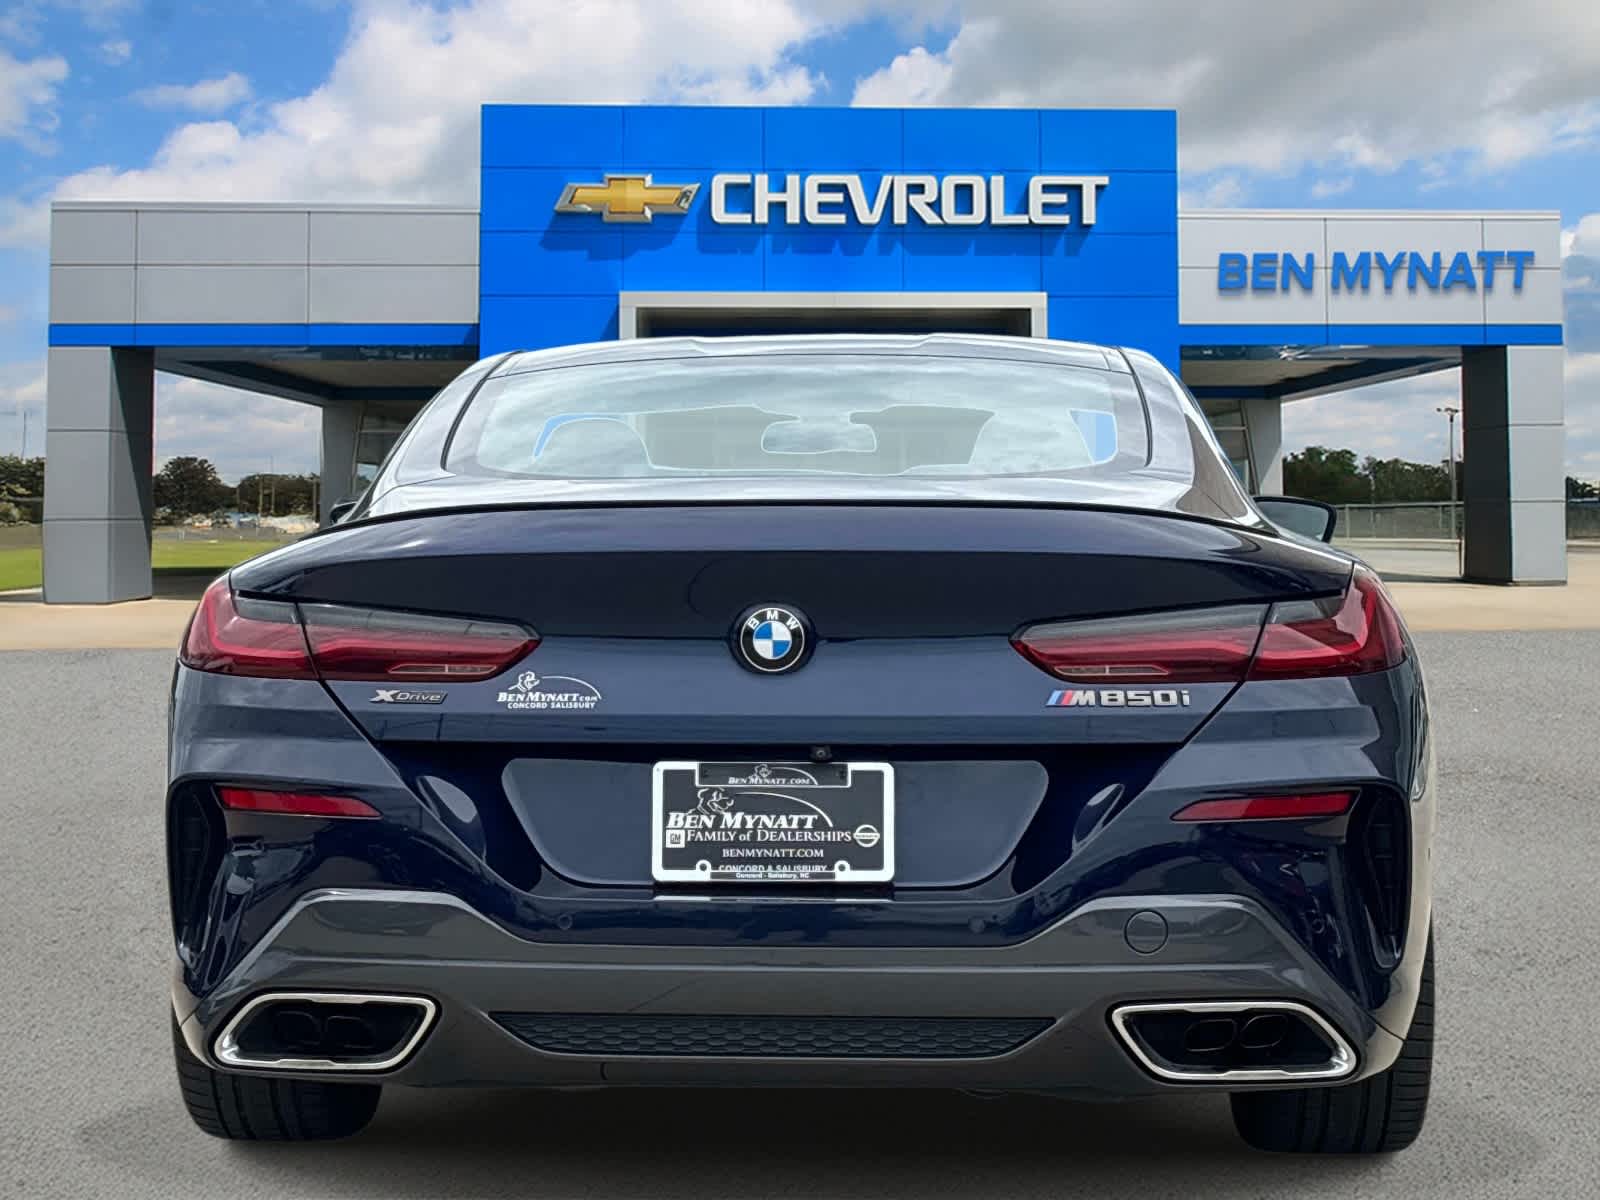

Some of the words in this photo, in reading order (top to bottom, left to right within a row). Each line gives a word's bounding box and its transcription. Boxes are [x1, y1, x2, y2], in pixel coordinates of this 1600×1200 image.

[711, 174, 1110, 225] CHEVROLET
[1217, 252, 1315, 290] BEN
[1331, 250, 1535, 290] MYNATT
[747, 609, 800, 631] BMW
[666, 812, 716, 829] BEN
[720, 812, 818, 829] MYNATT
[687, 830, 736, 842] FAMILY
[739, 830, 751, 842] of
[757, 830, 852, 842] DEALERSHIPS
[722, 848, 824, 858] BENMYNATT.COM
